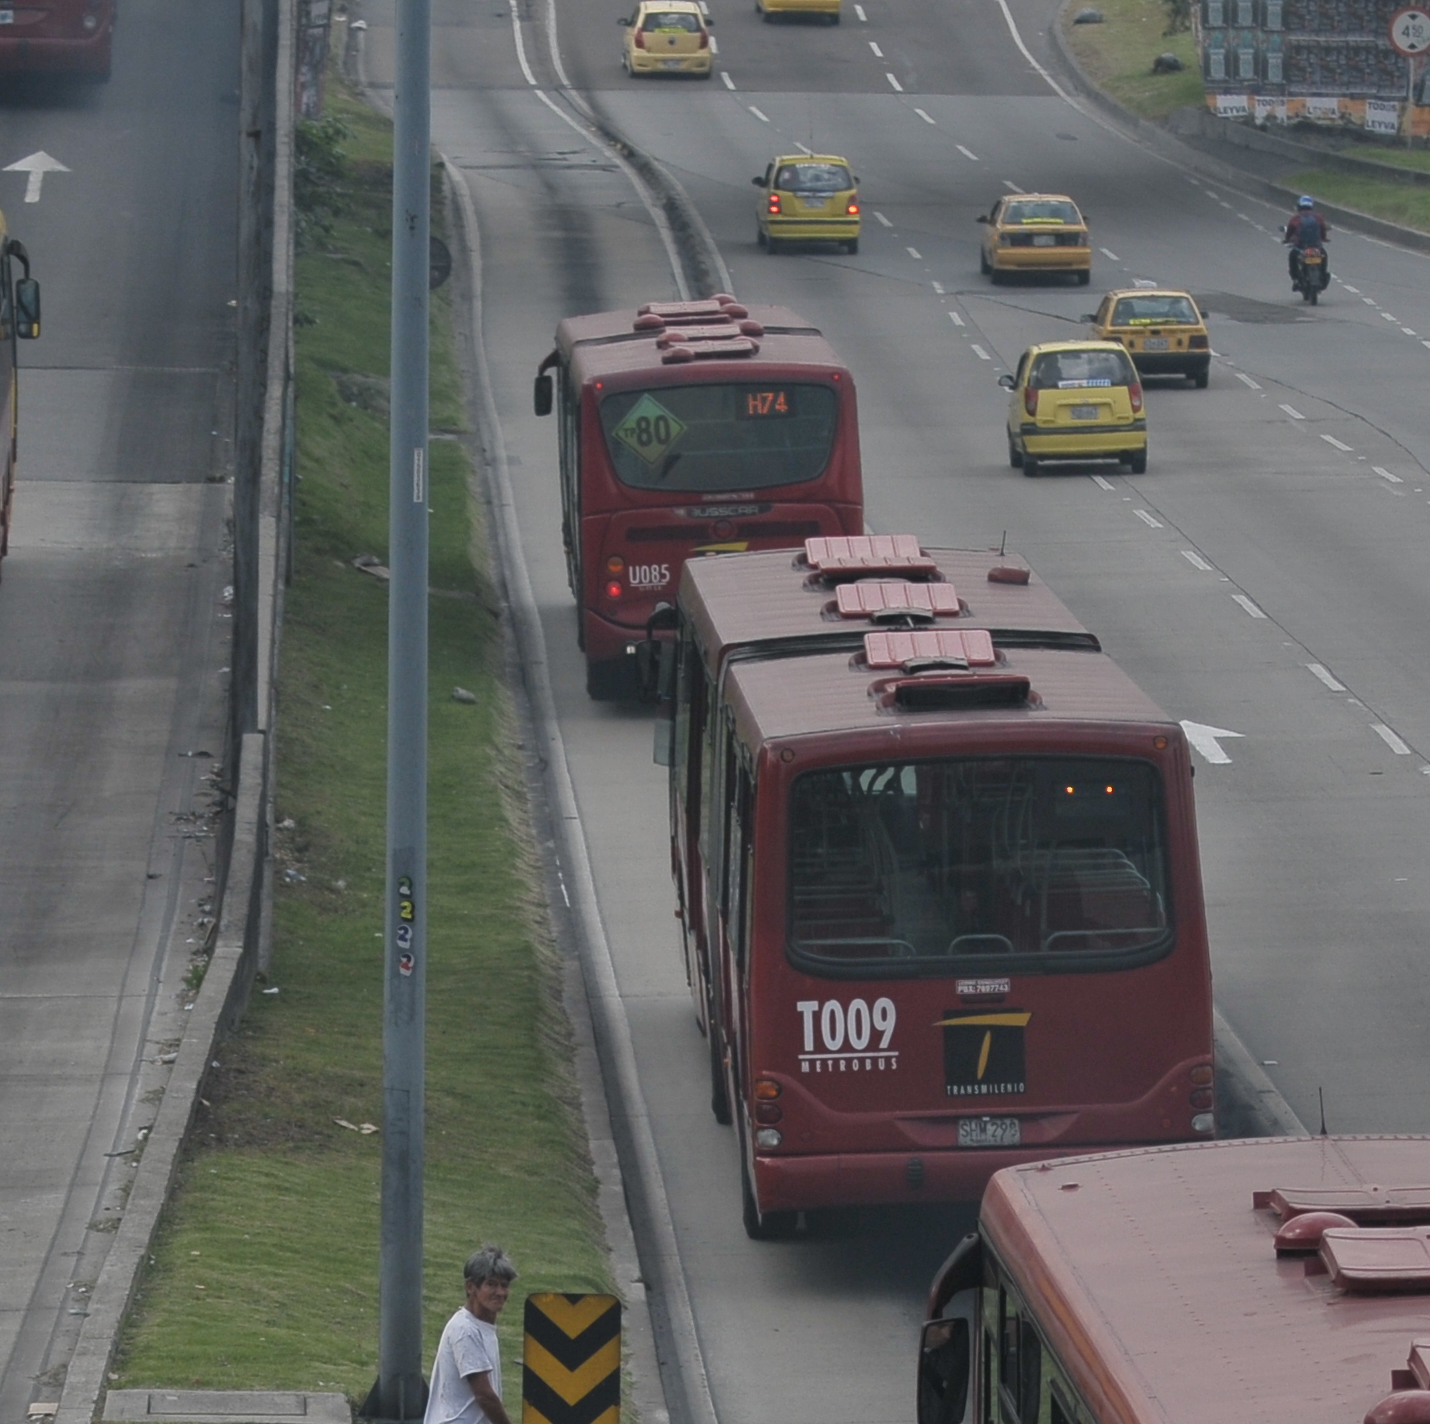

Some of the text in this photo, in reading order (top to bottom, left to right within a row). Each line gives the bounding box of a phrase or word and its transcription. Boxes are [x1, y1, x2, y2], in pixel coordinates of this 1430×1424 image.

[1218, 104, 1248, 116] LEYVA
[1366, 121, 1396, 131] LEYVA
[748, 391, 788, 414] H74
[636, 414, 671, 447] 80
[629, 564, 671, 584] U085
[796, 997, 897, 1051] T009
[801, 1057, 897, 1073] METROBUS
[946, 1083, 1025, 1096] TRANSMILENIO
